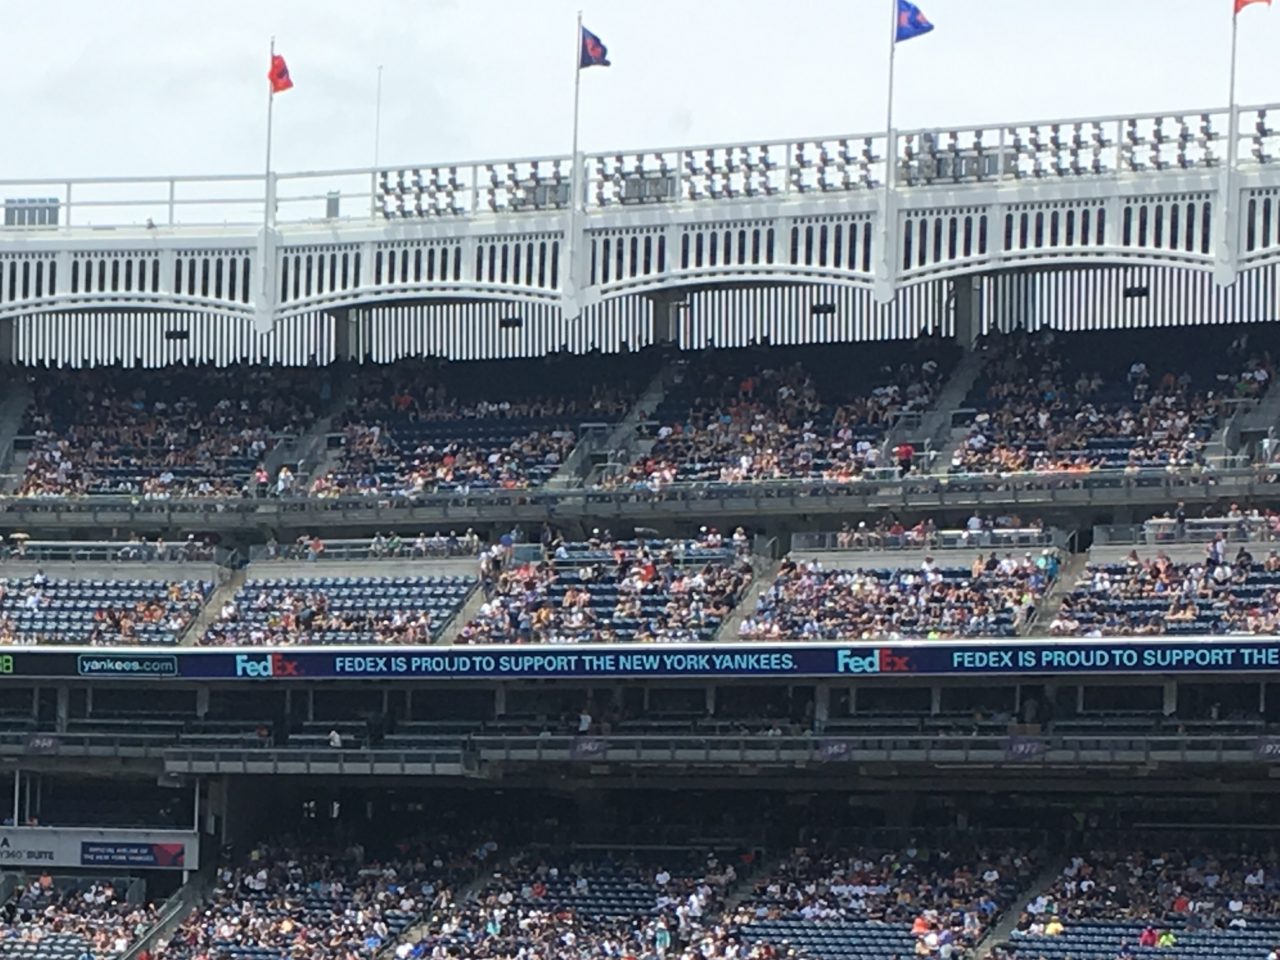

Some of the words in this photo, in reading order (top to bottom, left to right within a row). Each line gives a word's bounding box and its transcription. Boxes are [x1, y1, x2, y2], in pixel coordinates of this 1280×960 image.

[82, 658, 173, 672] yankees.com
[236, 654, 298, 676] FedEx
[335, 657, 387, 672] FEDEX
[391, 657, 407, 672] IS
[411, 657, 470, 672] PROUD
[472, 656, 495, 671] TO
[499, 656, 578, 671] SUPPORT
[582, 655, 616, 670] THE
[619, 655, 660, 670] NEW
[663, 655, 711, 670] YORK
[712, 654, 798, 670] YANKEES.
[837, 649, 910, 672] FedEx
[953, 652, 1013, 668] FEDEX
[1018, 651, 1036, 667] IS
[1041, 651, 1109, 667] PROUD
[1111, 650, 1138, 666] TO
[1143, 649, 1236, 665] SUPPORT
[1240, 648, 1279, 665] THE
